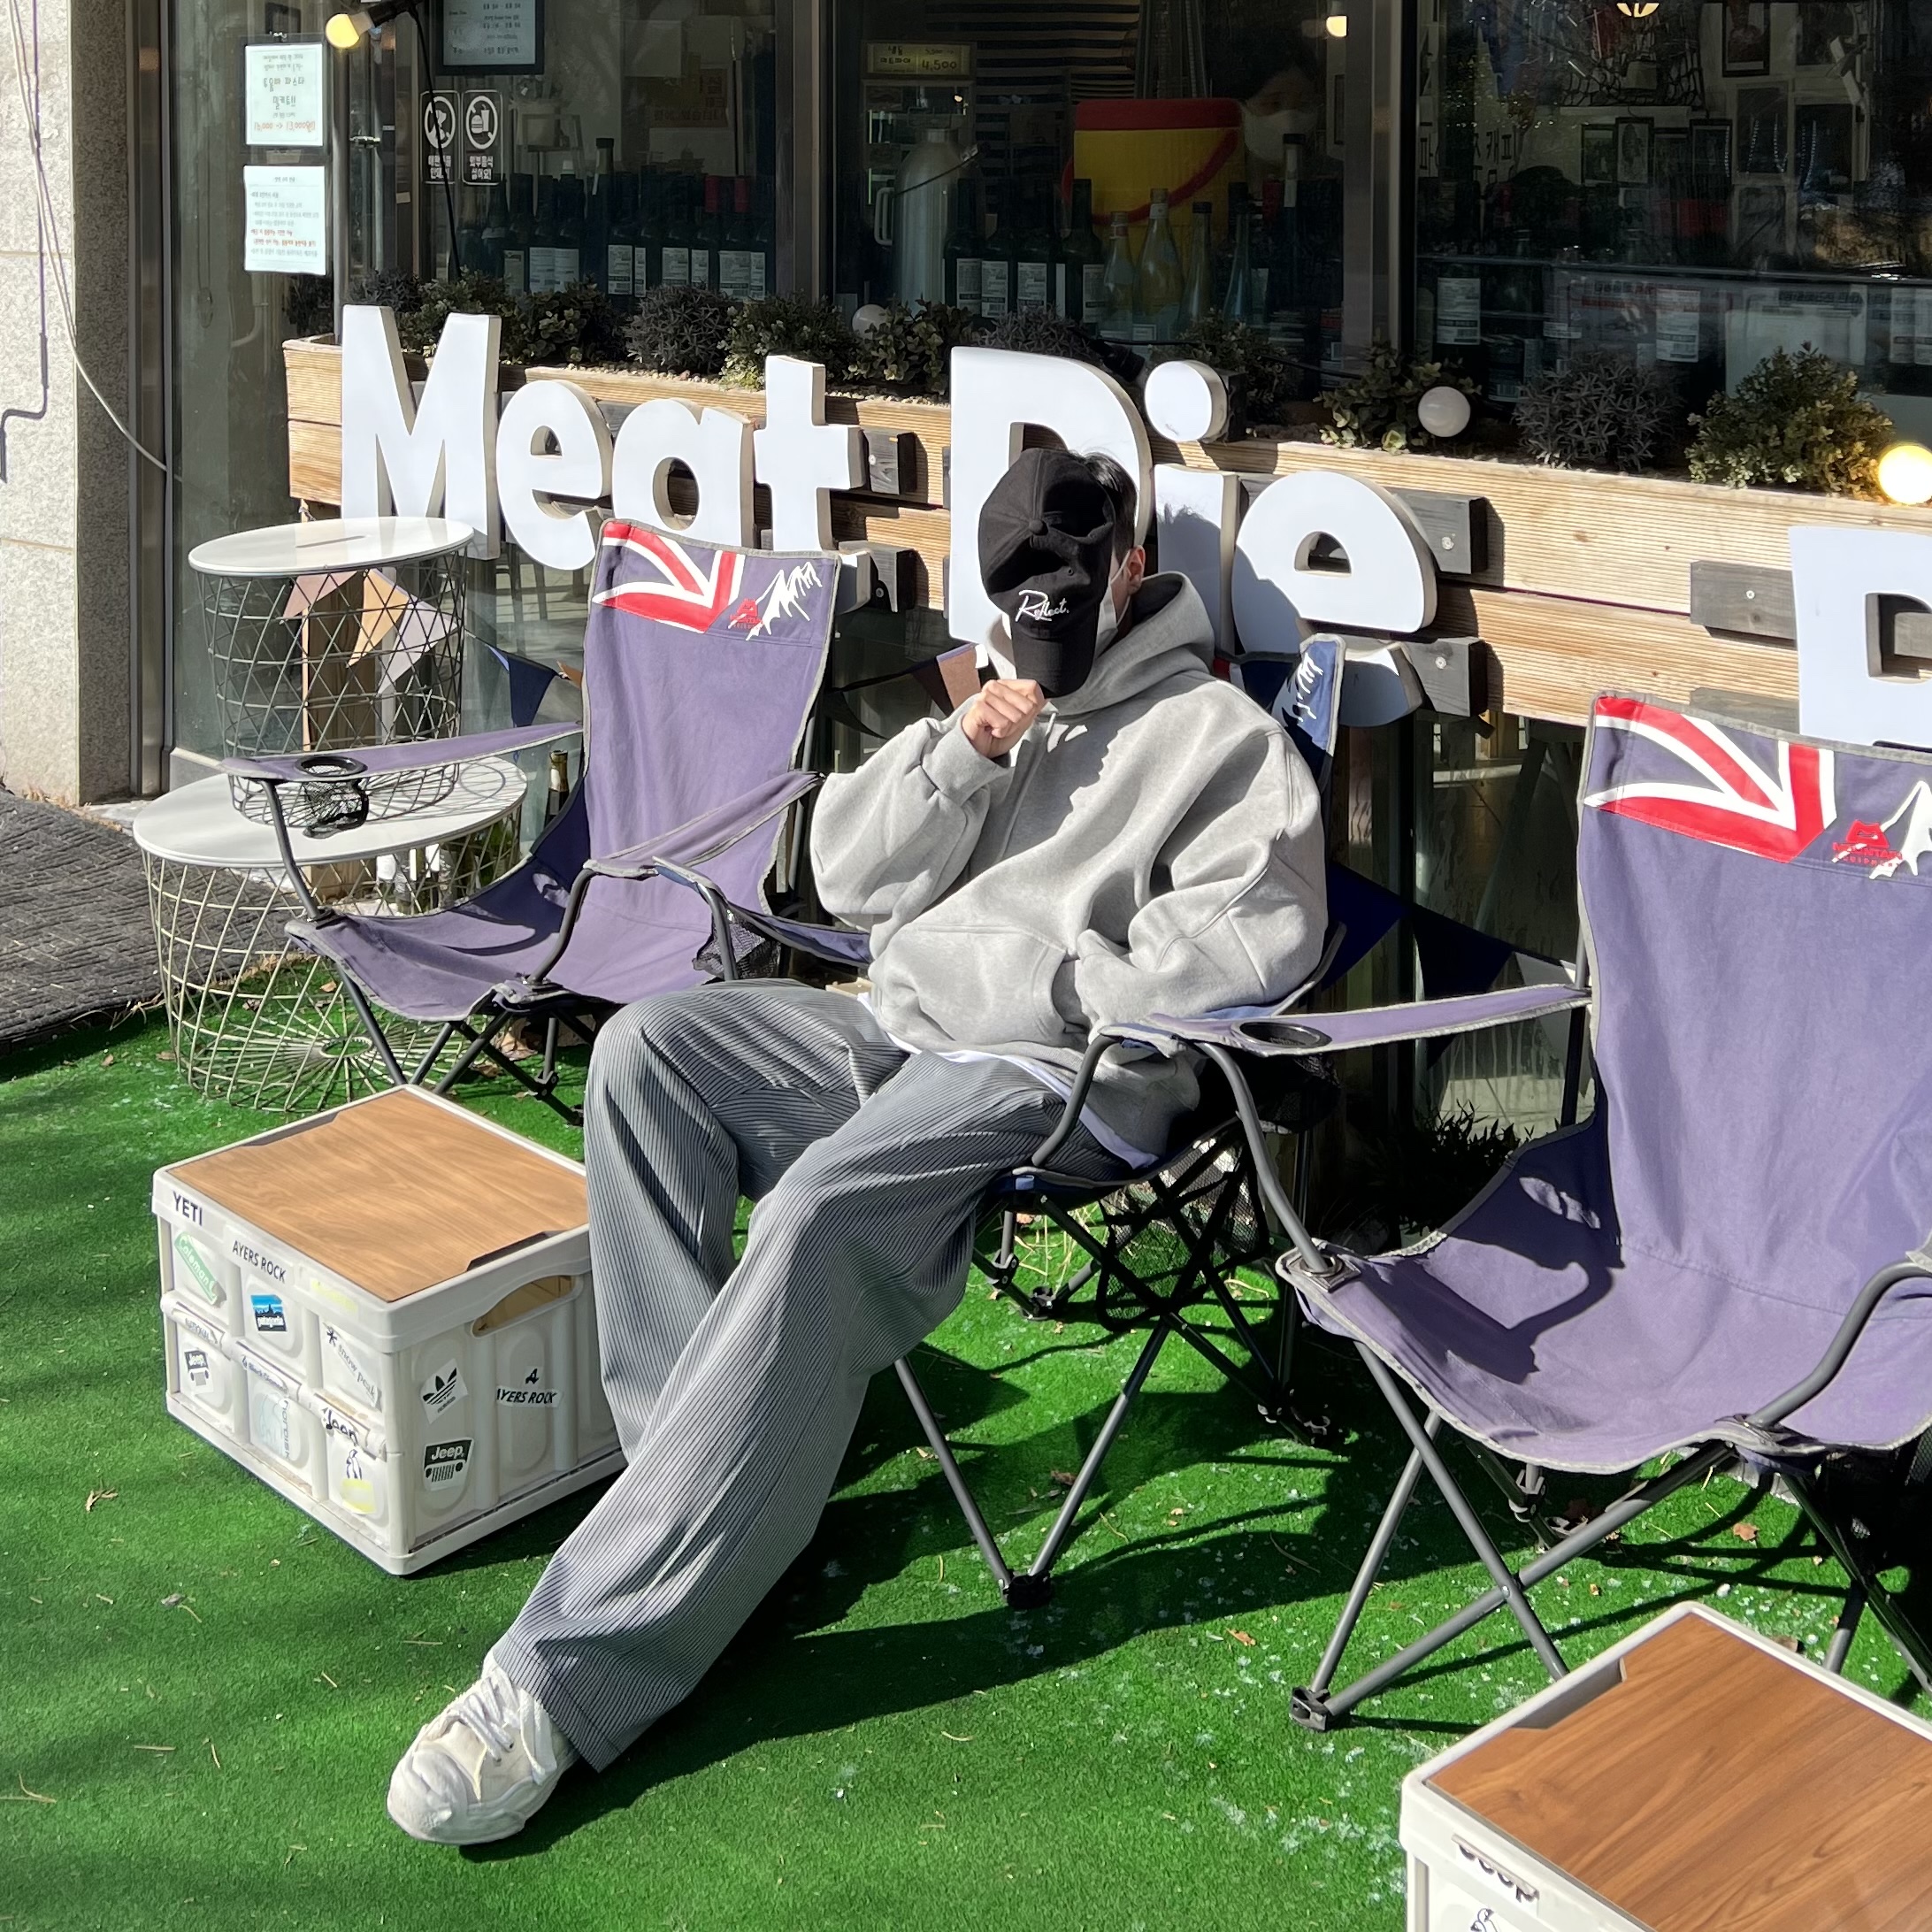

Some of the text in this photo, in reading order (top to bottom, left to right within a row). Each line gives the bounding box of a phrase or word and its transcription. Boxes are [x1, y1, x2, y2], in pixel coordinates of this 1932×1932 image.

[922, 59, 957, 71] 4,500
[341, 303, 869, 606] Meat
[949, 346, 1438, 726] Pie
[172, 1190, 203, 1227] YETI
[232, 1240, 288, 1284] AYERS ROCK
[338, 1344, 376, 1397] snow peak
[431, 1445, 463, 1460] Jeep
